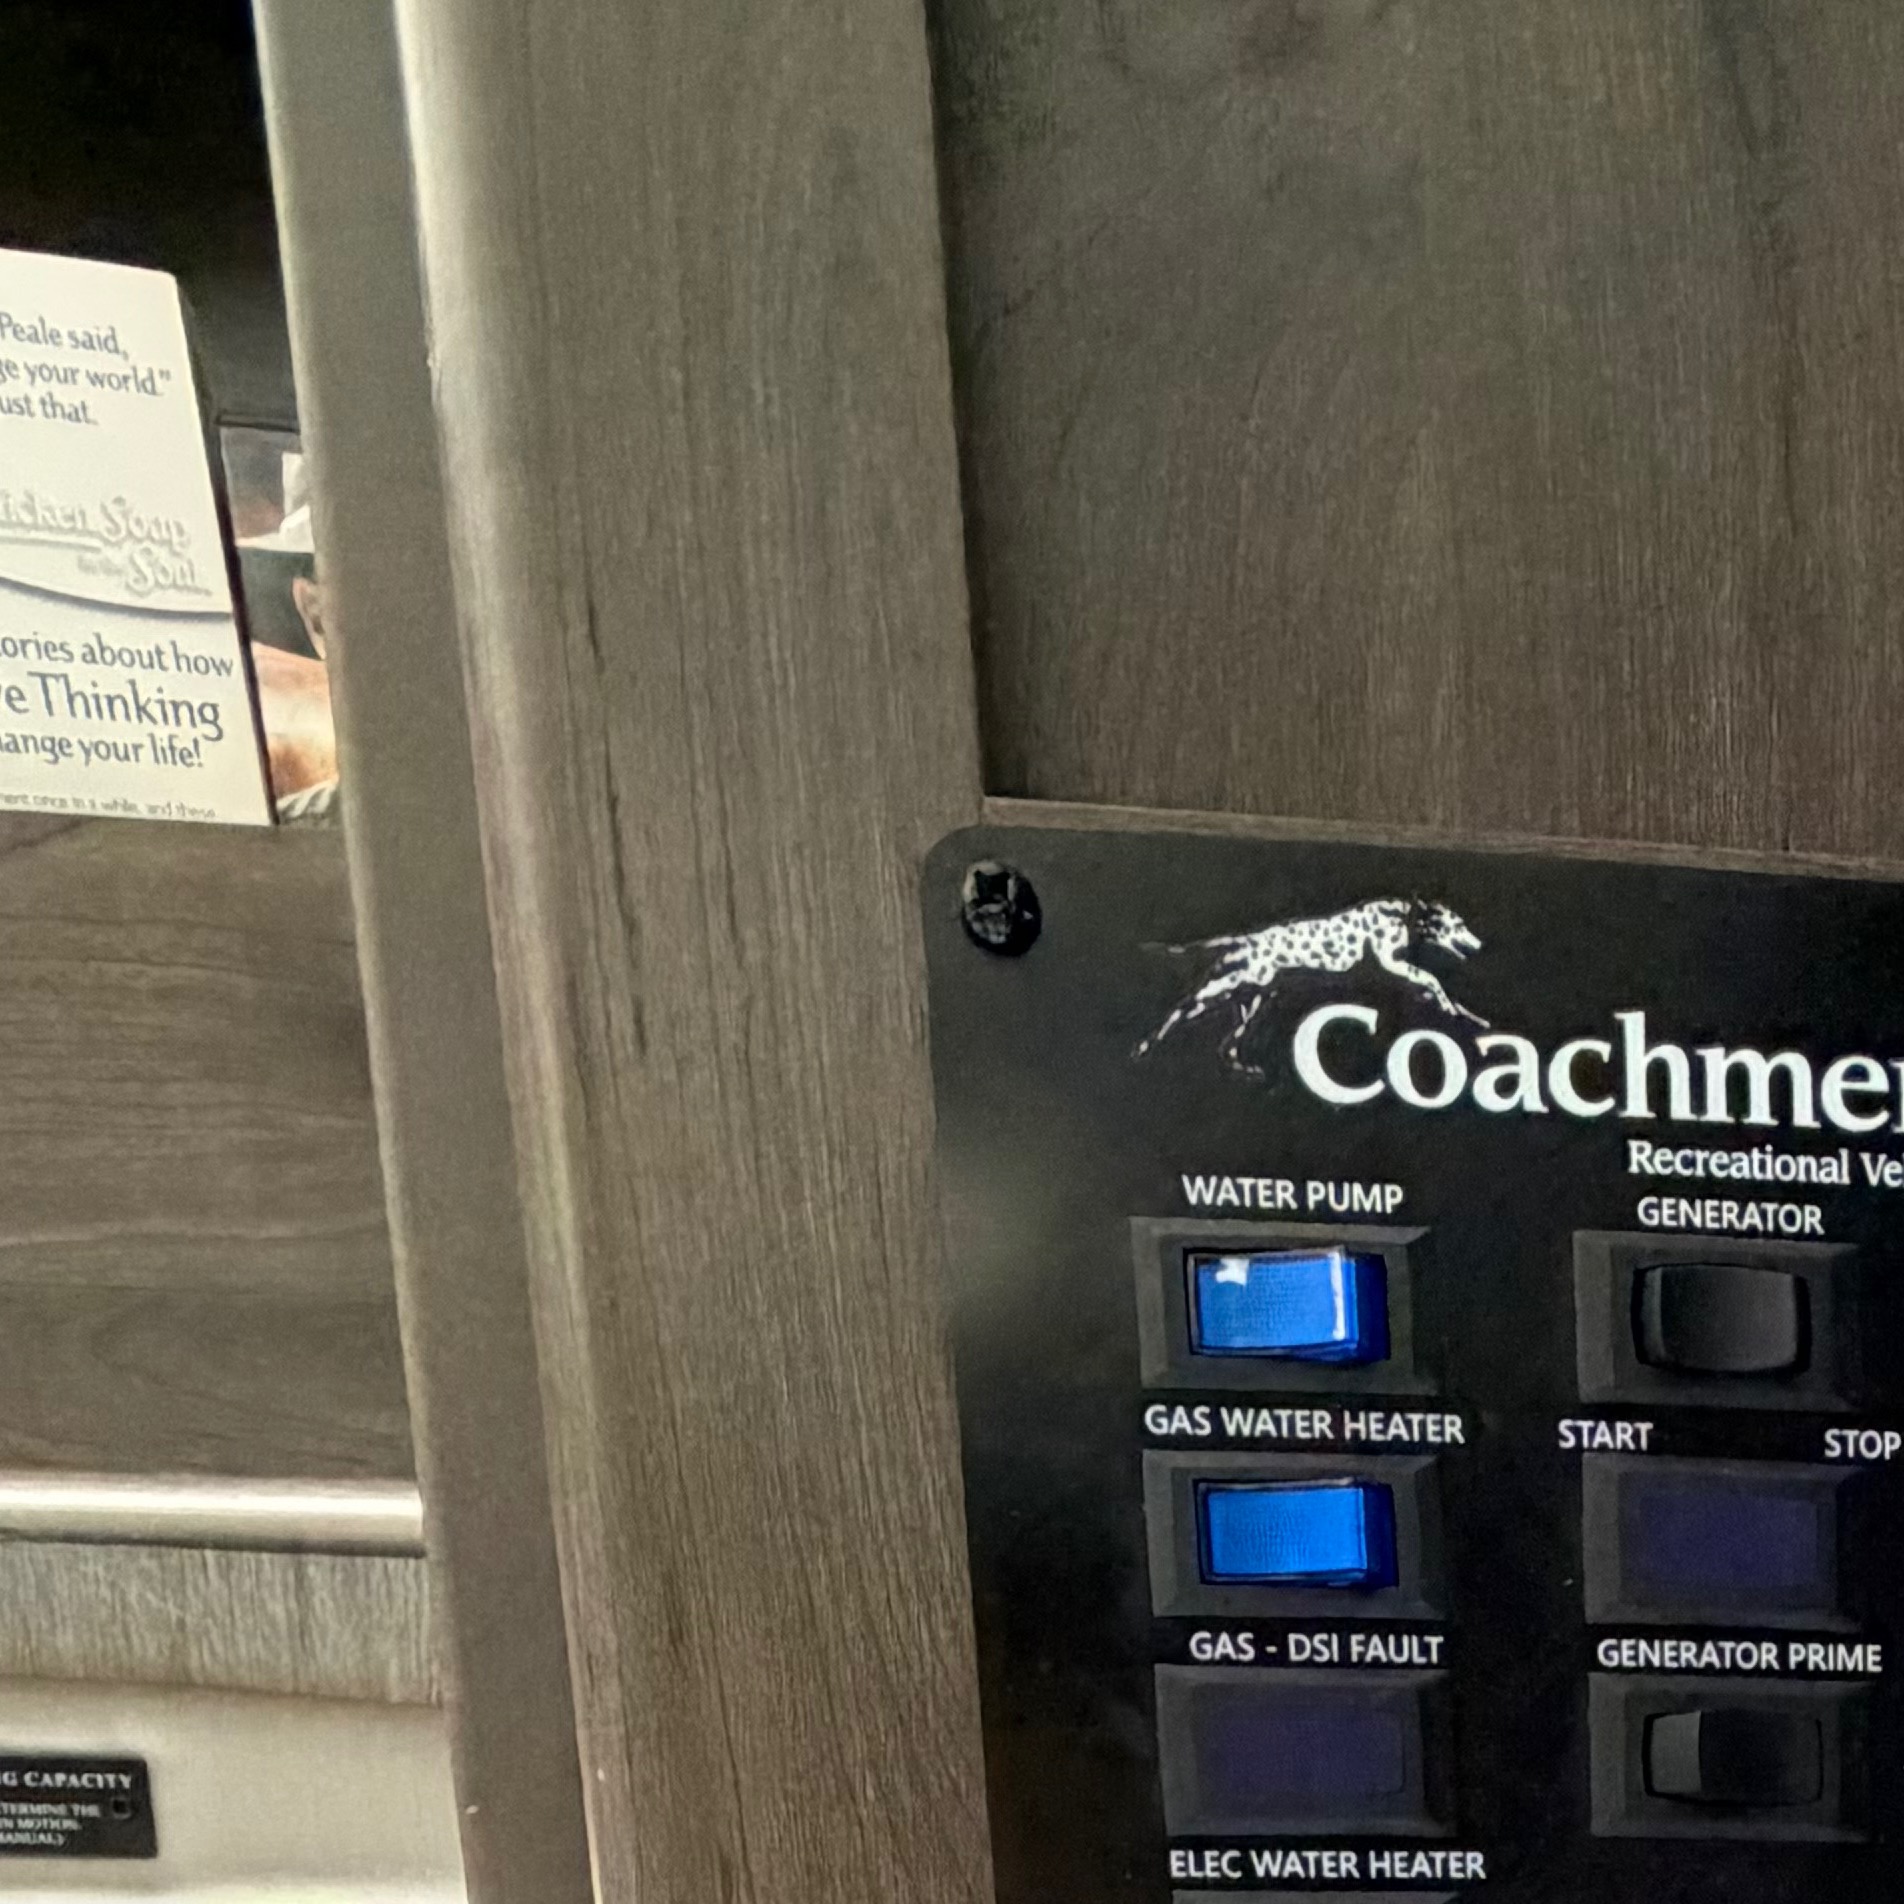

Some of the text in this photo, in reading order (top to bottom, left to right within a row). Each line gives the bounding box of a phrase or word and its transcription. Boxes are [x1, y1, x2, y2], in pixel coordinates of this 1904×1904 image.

[67, 325, 129, 361] said,
[23, 362, 80, 387] your
[0, 394, 98, 425] ust that.
[0, 631, 234, 677] ories about how
[26, 669, 224, 743] Thinking
[77, 738, 145, 767] your
[151, 732, 207, 768] life!
[1627, 1139, 1851, 1185] Recreational
[1181, 1174, 1404, 1214] WATER PUMP
[1636, 1196, 1825, 1235] GENERATOR
[1144, 1404, 1466, 1444] GAS WATER HEATER
[1558, 1418, 1654, 1451] START
[1824, 1428, 1902, 1460] STOP
[1188, 1630, 1444, 1664] GAS - DSI FAULT
[1596, 1638, 1883, 1673] GENERATOR PRIME
[23, 1771, 132, 1789] CAPACITY
[1169, 1849, 1487, 1880] ELEC WATER HEATER
